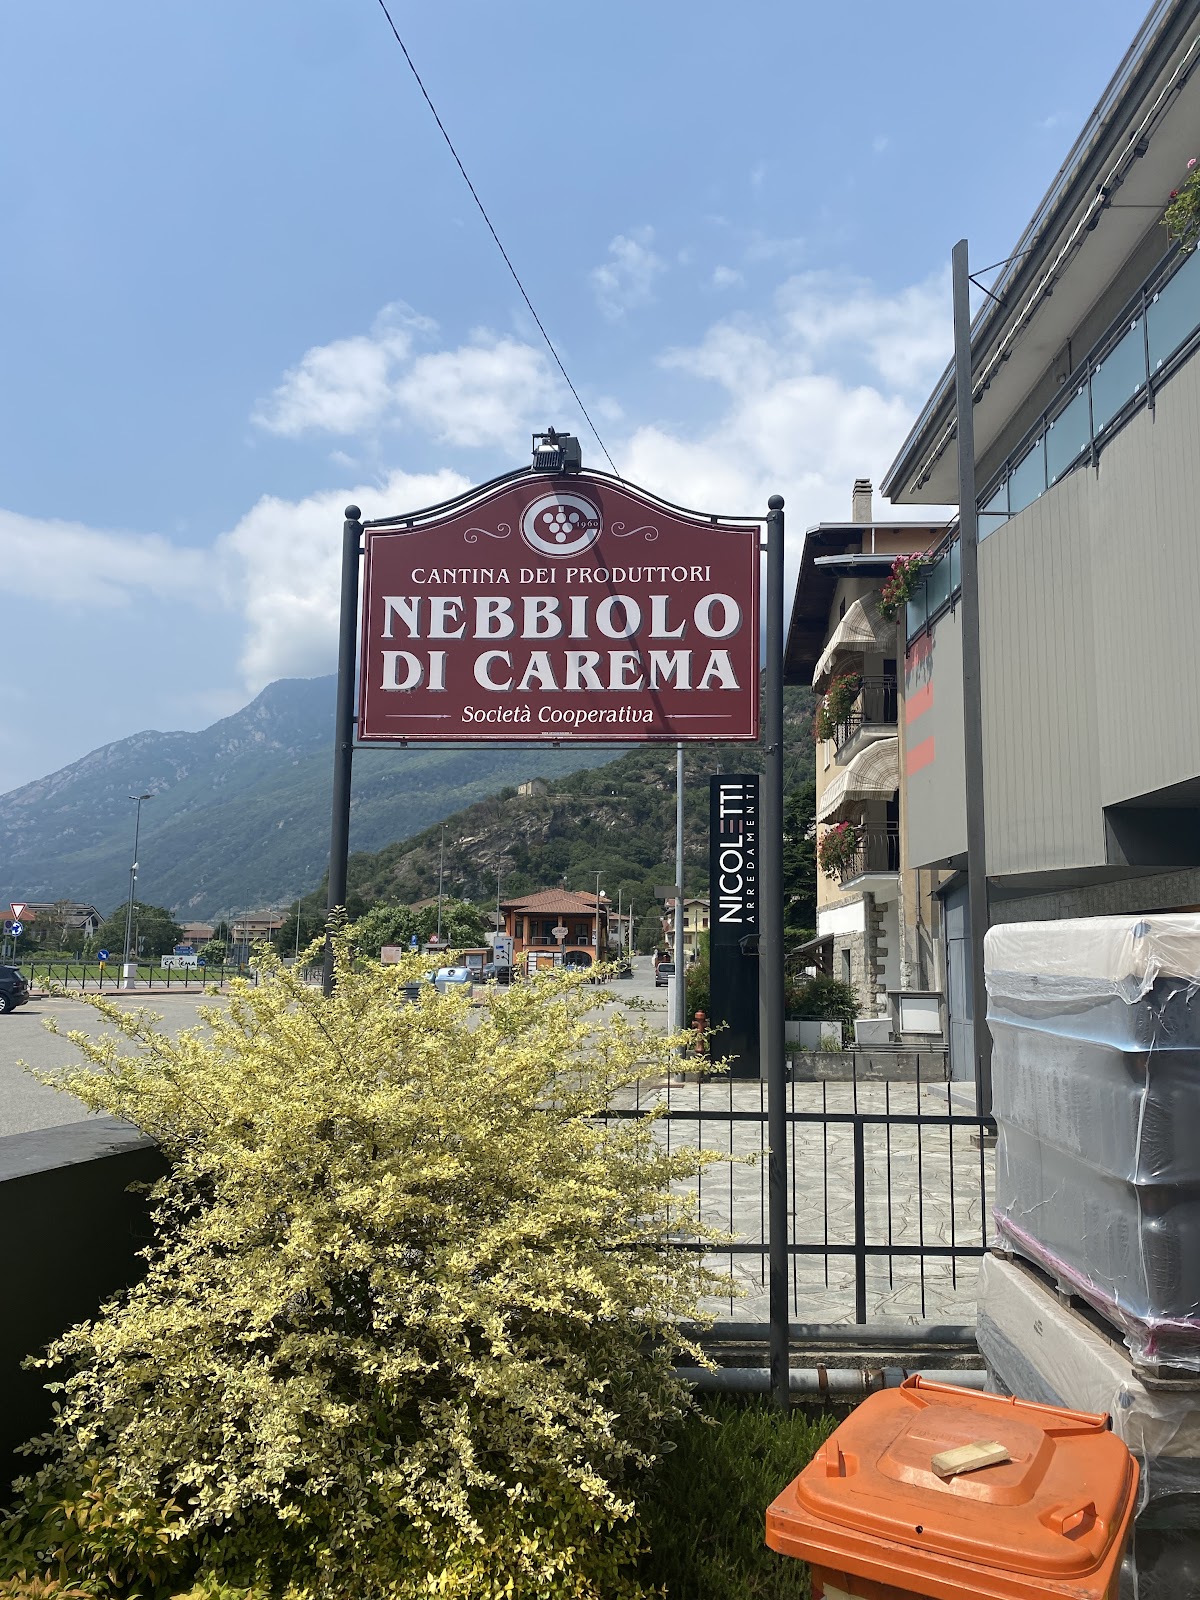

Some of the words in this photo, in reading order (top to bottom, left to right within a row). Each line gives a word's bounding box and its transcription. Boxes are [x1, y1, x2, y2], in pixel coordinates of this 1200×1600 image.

[577, 519, 599, 529] 1960
[411, 568, 511, 584] CANTINA
[519, 567, 557, 584] DEI
[565, 566, 711, 583] PRODUTTORI
[380, 593, 741, 639] NEBBIOLO
[379, 650, 446, 691] DI
[473, 649, 741, 691] CAREMA
[461, 704, 531, 723] Società
[538, 705, 654, 728] Cooperativa
[719, 785, 743, 923] NICOLETTI
[746, 785, 755, 924] ARREDAMENTI
